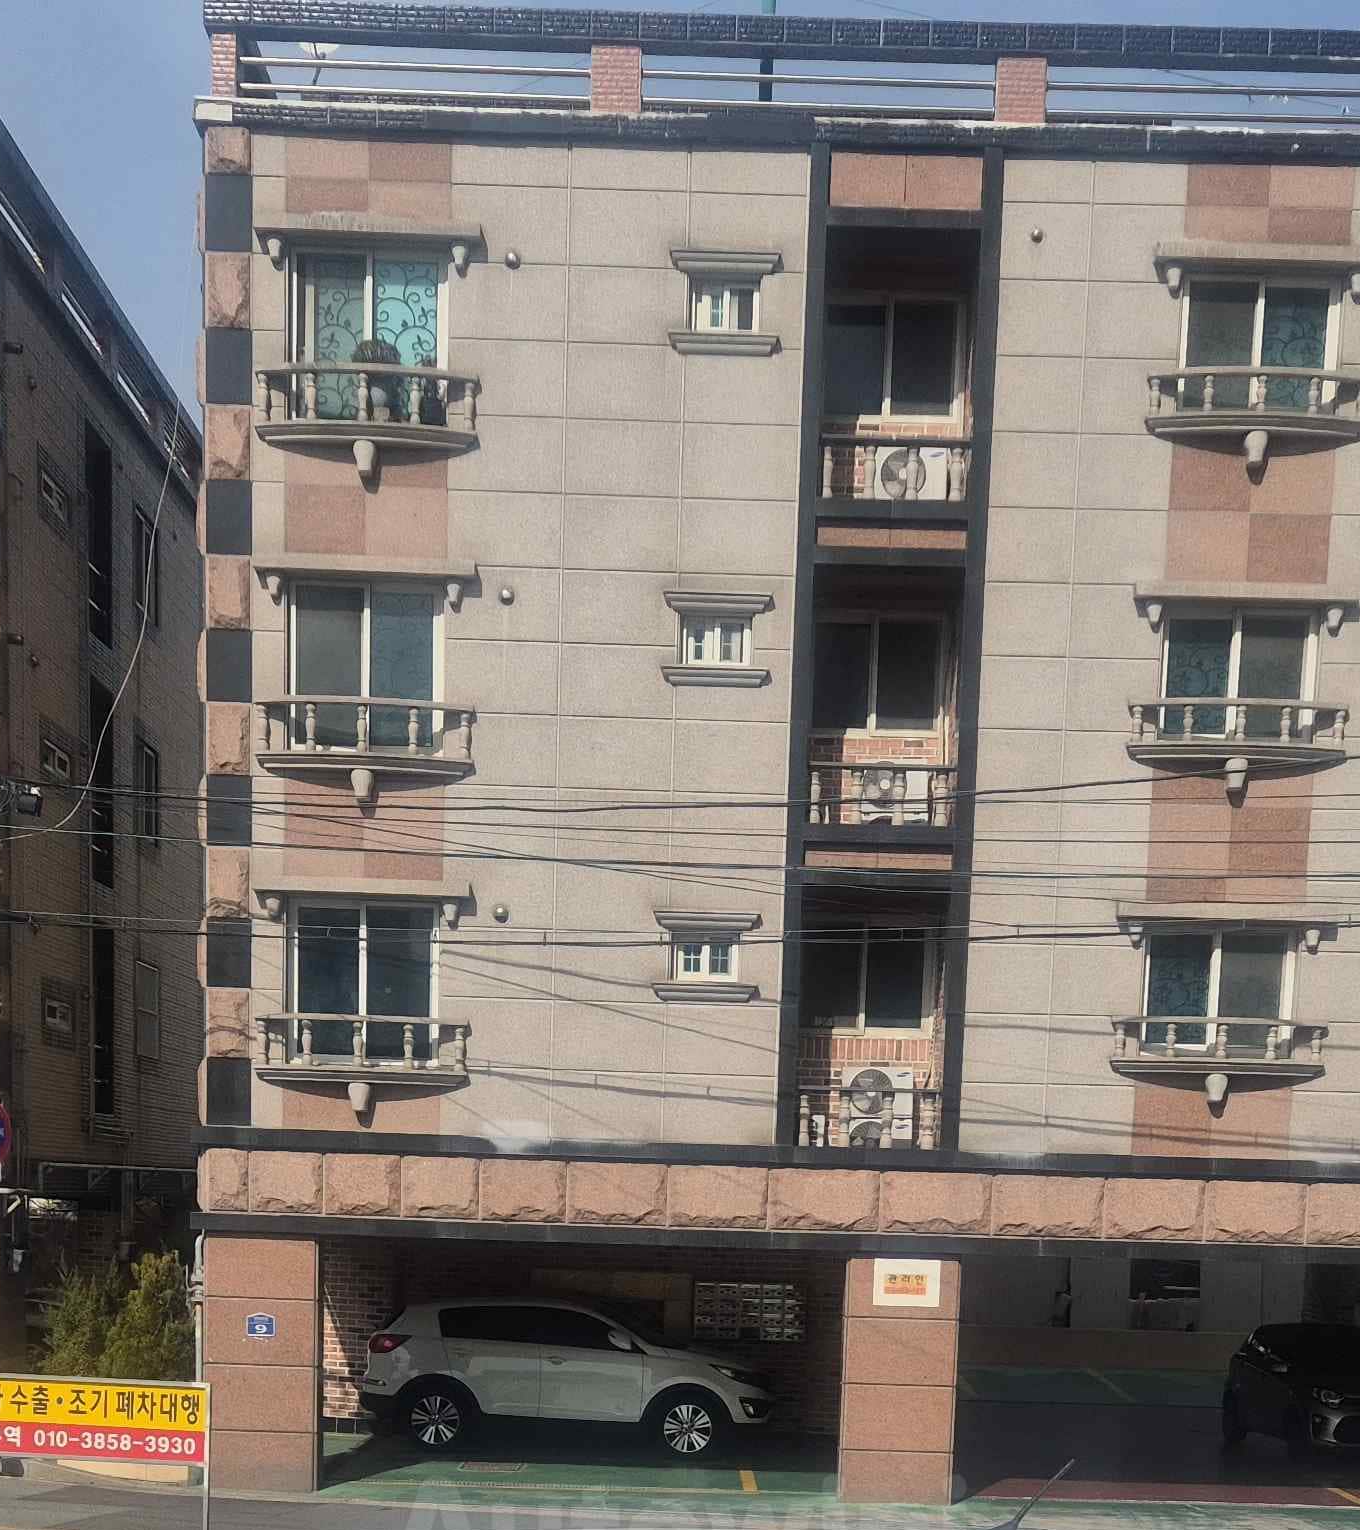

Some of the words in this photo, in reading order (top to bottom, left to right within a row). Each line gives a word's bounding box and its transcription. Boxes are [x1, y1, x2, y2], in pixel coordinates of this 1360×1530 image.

[254, 1324, 267, 1334] 9
[116, 1391, 200, 1425] 폐차대행
[33, 1430, 196, 1455] 010-3858-3930
